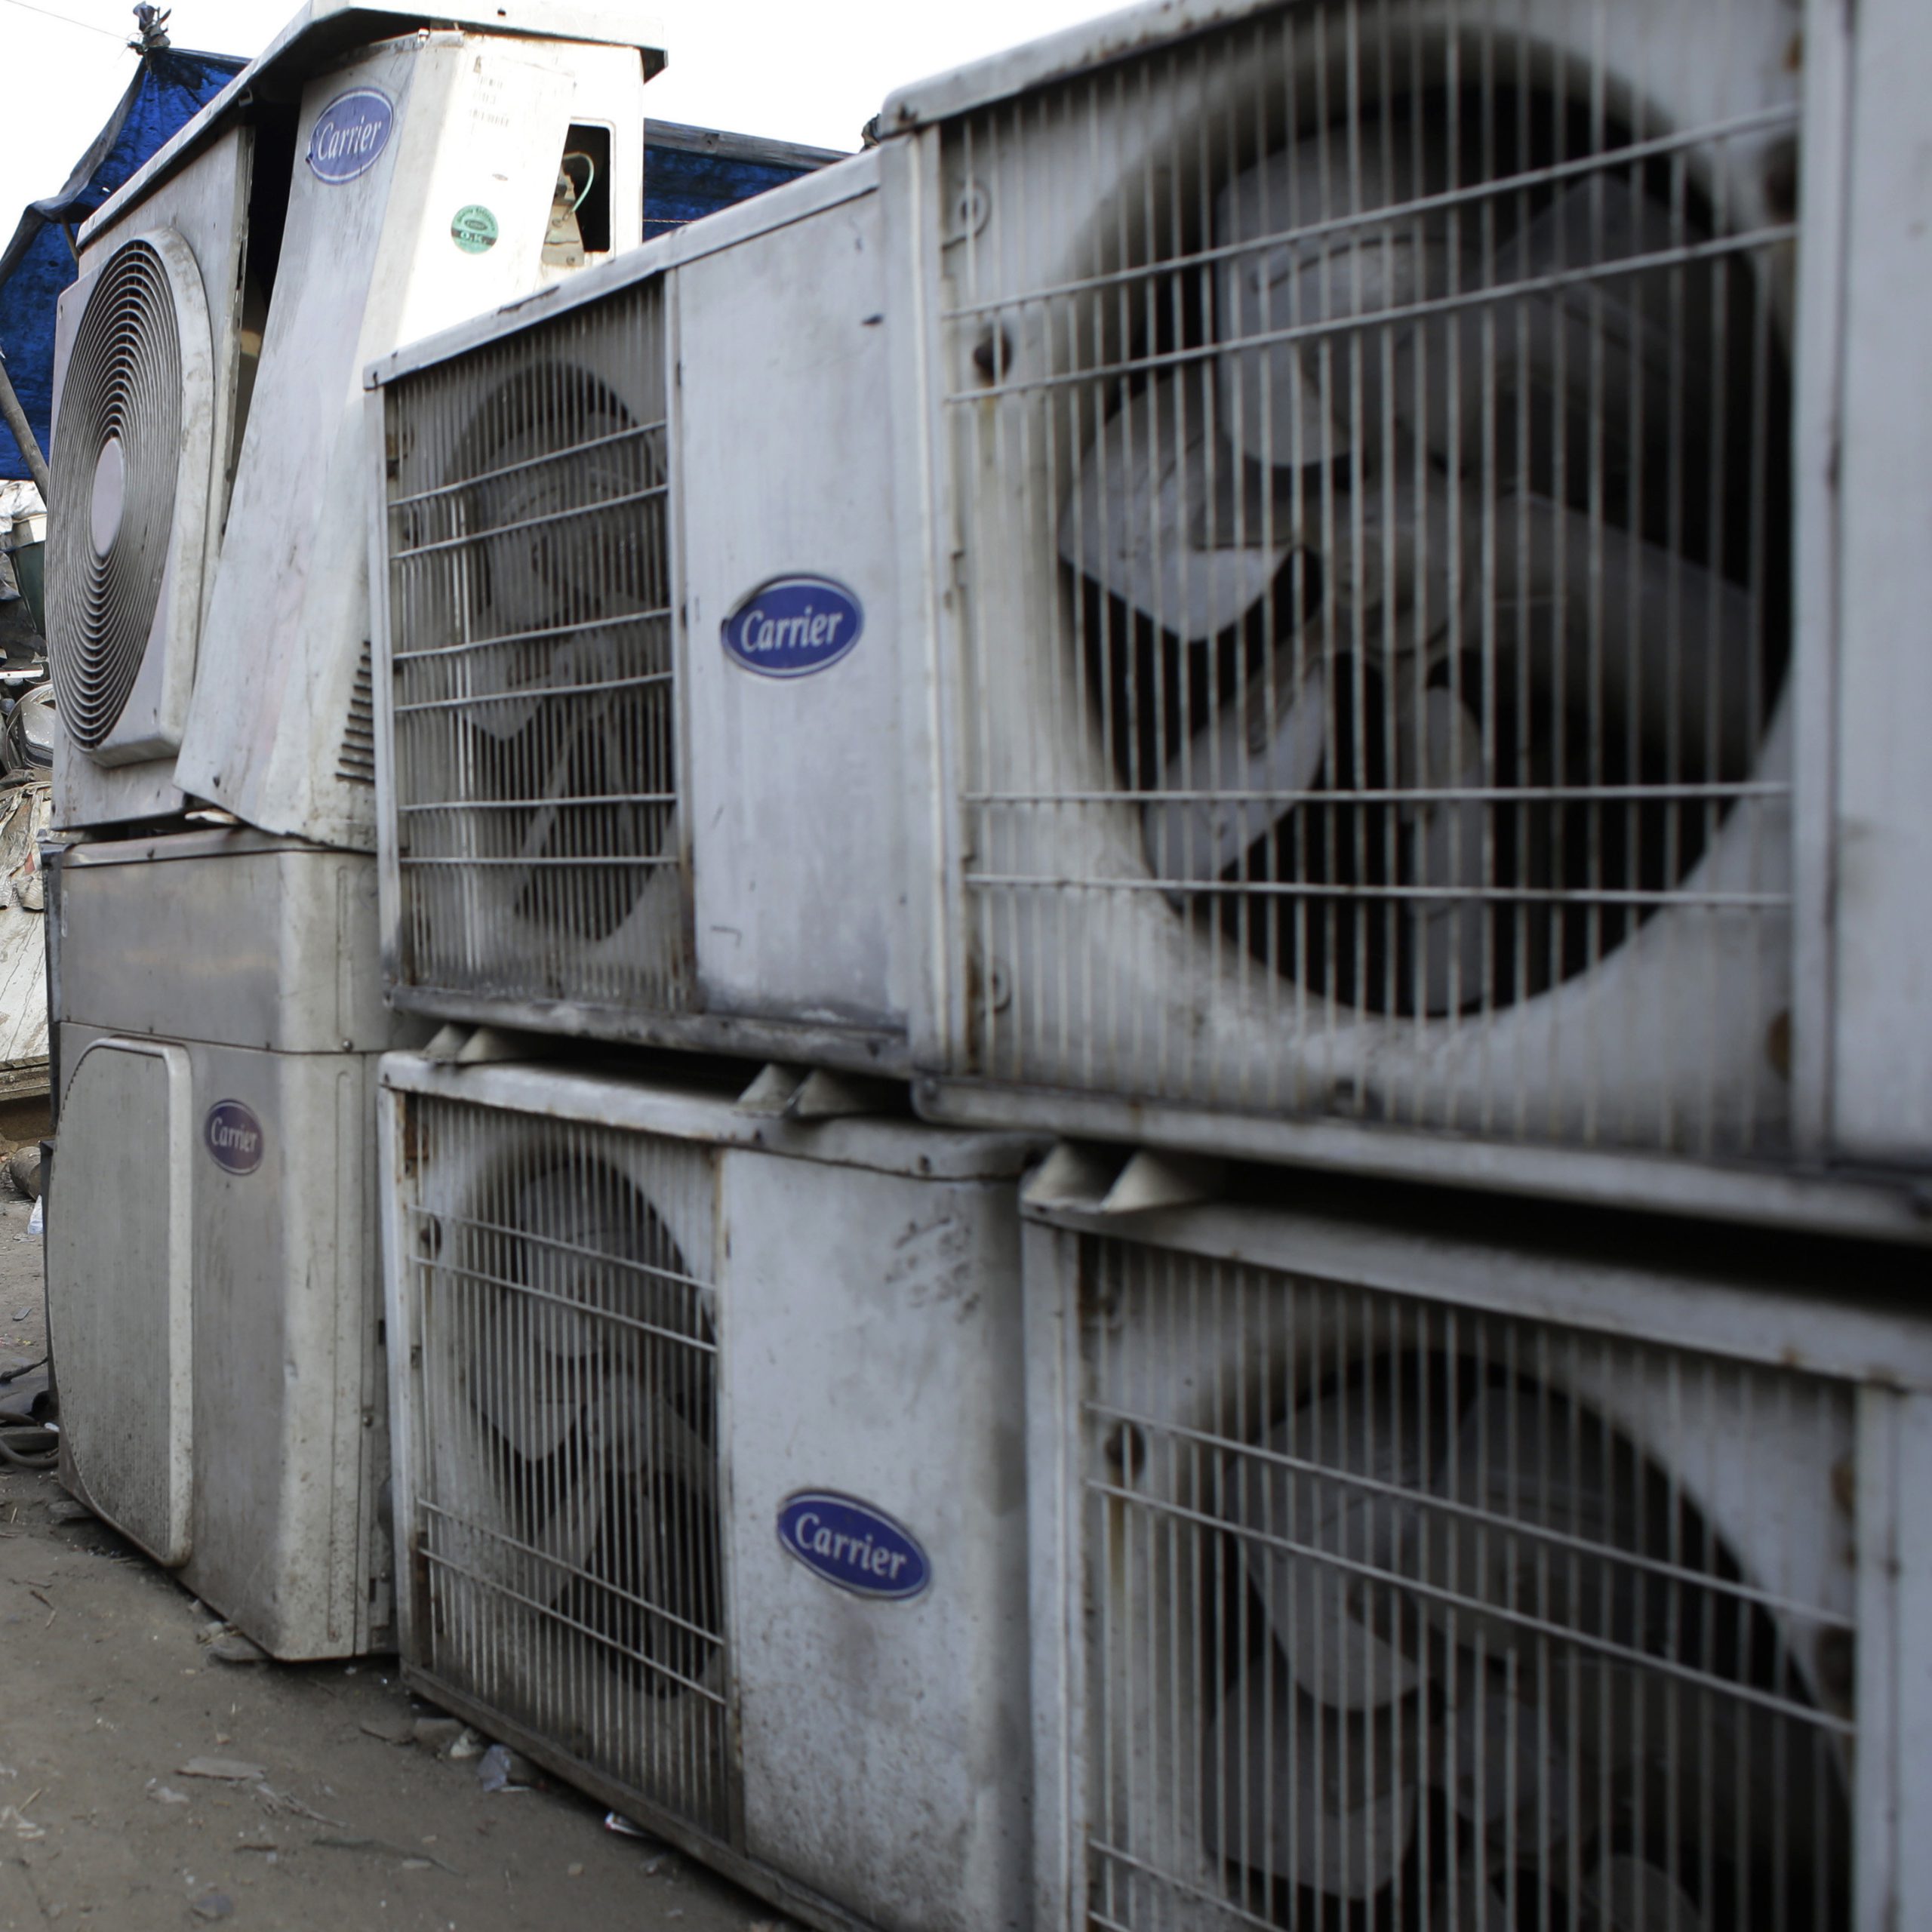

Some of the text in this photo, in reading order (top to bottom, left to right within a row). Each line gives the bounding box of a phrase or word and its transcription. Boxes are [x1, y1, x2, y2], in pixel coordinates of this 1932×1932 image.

[318, 115, 382, 161] Carrier
[740, 605, 843, 654] Carrier
[211, 1116, 257, 1152] Carrier
[795, 1512, 907, 1580] Carrier
